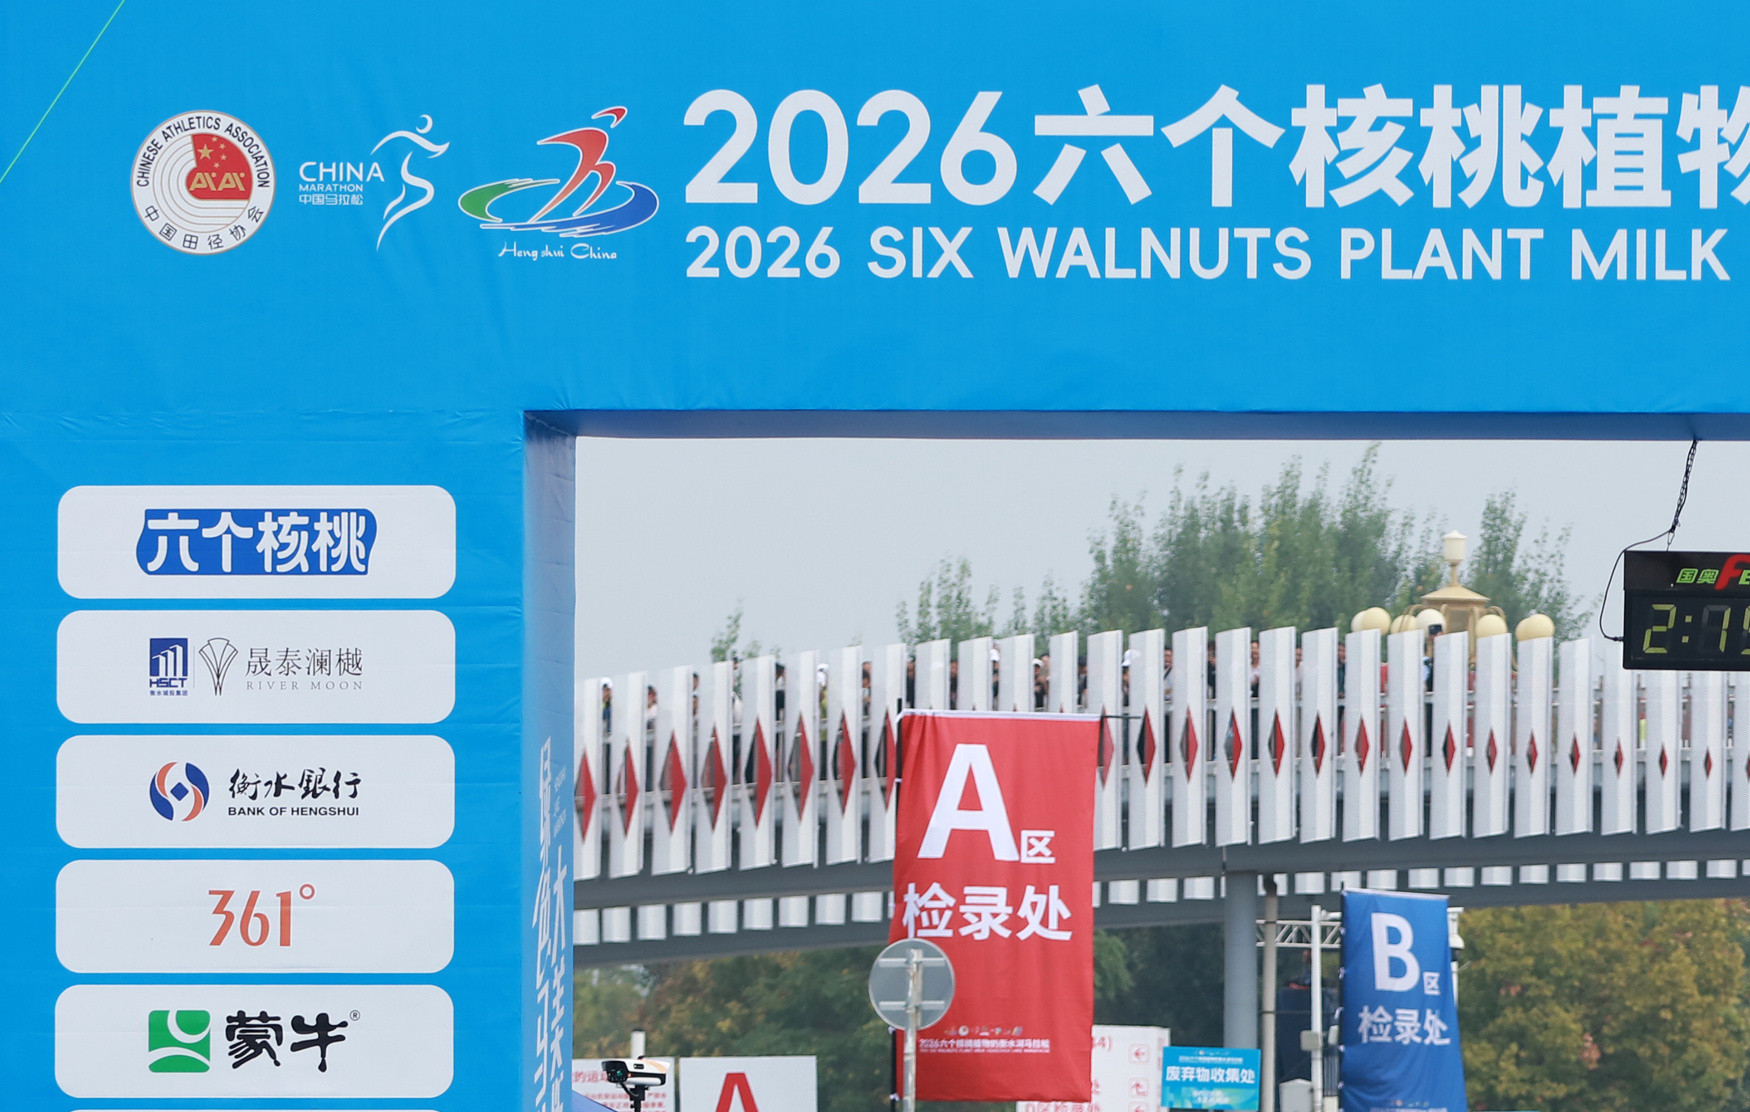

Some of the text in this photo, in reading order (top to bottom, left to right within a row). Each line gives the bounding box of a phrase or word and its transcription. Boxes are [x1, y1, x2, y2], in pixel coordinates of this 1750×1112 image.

[136, 116, 270, 188] CHINESE ATHLETICS ASSOCIATION
[299, 161, 385, 182] CHINA
[299, 183, 364, 192] MARATHON
[299, 193, 364, 206] 中国马拉松
[144, 205, 264, 250] 中国田径协会
[570, 242, 617, 260] China
[685, 225, 841, 279] 2026
[867, 225, 974, 279] SIX
[996, 226, 1312, 280] WALNUTS
[1340, 227, 1545, 280] PLANT
[1571, 228, 1731, 281] MILK
[146, 511, 366, 574] 六个核桃
[149, 677, 188, 688] HSCT
[245, 647, 362, 678] 晟泰澜樾
[246, 680, 363, 691] RIVER MOON
[228, 806, 359, 816] BANK OF HENGSHUI
[917, 743, 1056, 864] A区
[208, 884, 315, 948] 361°
[903, 882, 1072, 941] 检录处
[1371, 912, 1441, 996] B区
[225, 1009, 349, 1073] 蒙牛
[1358, 1005, 1451, 1046] 检录处
[1165, 1066, 1256, 1084] 废弃物收集处
